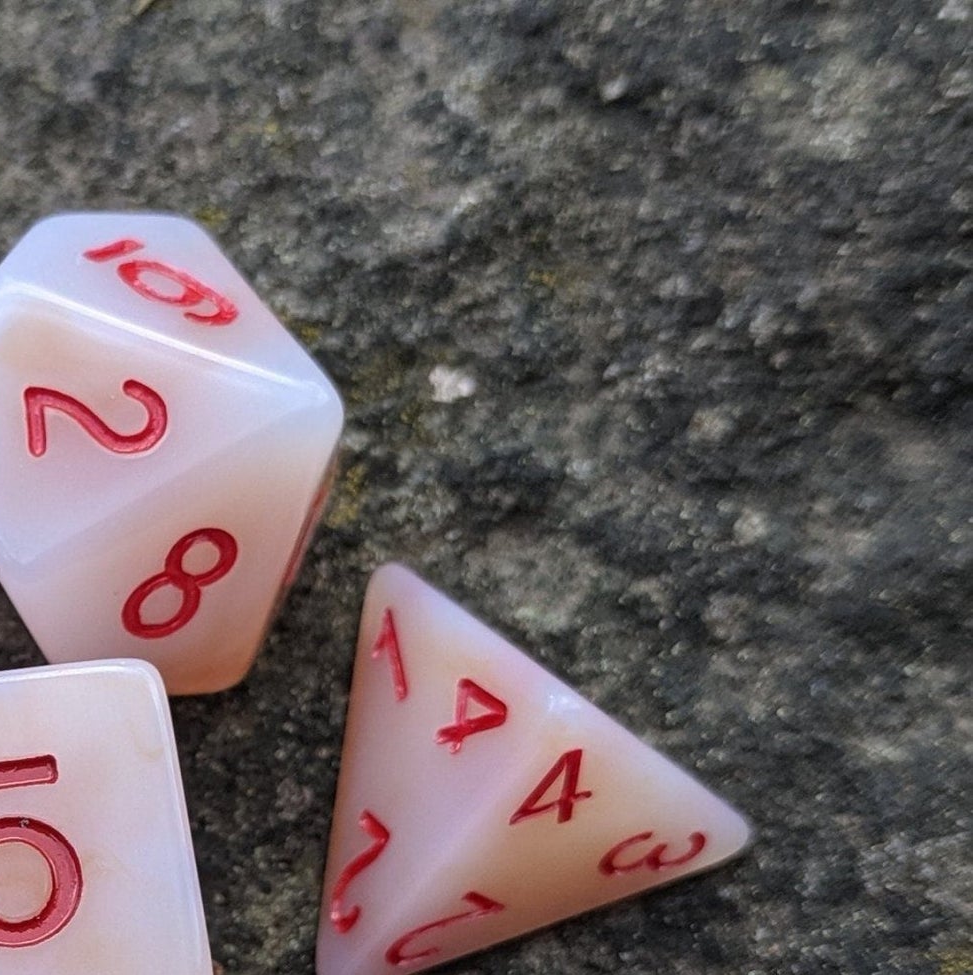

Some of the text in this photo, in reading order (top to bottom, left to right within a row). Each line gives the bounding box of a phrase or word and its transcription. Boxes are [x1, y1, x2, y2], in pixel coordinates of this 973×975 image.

[23, 379, 169, 457] 2
[121, 527, 238, 640] 8
[372, 611, 409, 701] 1
[436, 679, 509, 754] 4
[510, 749, 591, 823] 4
[330, 811, 390, 935] 2
[599, 833, 706, 877] 3
[385, 891, 505, 966] 2
